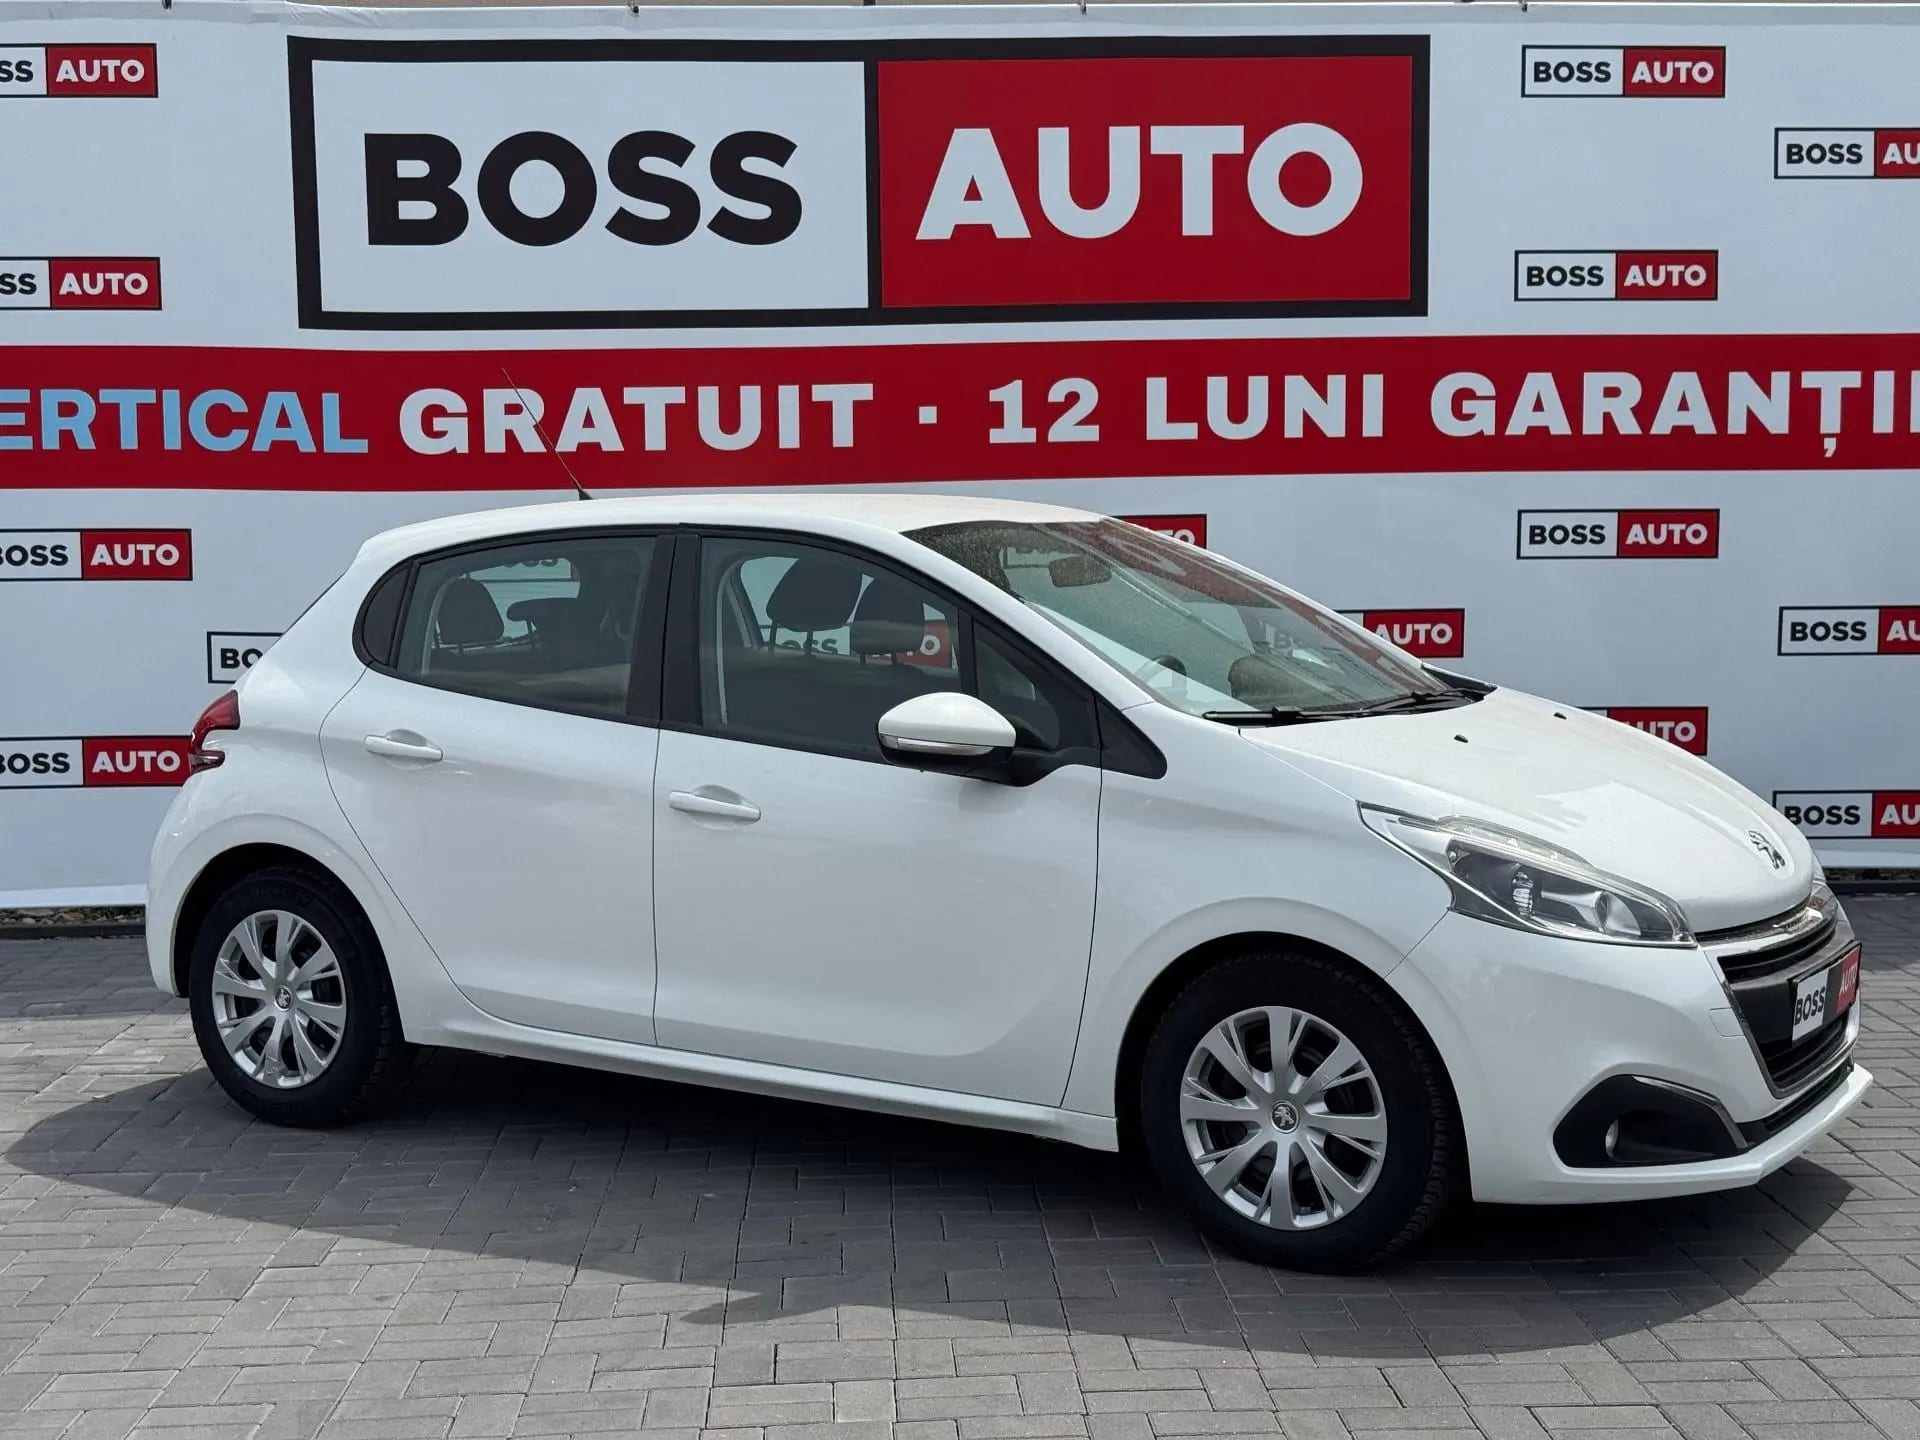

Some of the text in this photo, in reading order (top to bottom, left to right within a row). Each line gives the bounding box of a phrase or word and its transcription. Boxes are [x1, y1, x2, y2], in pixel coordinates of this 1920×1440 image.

[56, 60, 144, 83] AUTO
[1533, 61, 1714, 83] BOSS AUTO
[1786, 144, 1863, 164] BOSS
[364, 123, 1362, 246] BOSS AUTO
[59, 273, 148, 295] AUTO
[1526, 265, 1706, 286] BOSS AUTO
[0, 389, 368, 453] ERTICAL
[400, 383, 873, 454] GRATUIT
[989, 378, 1099, 444] 12
[1146, 374, 1384, 441] LUNI
[1431, 370, 1920, 457] GARANȚI
[1528, 523, 1707, 545] BOSS AUTO
[0, 544, 180, 566] OSS AUTO
[1374, 623, 1453, 645] AUTO
[1790, 621, 1867, 641] BOSS
[0, 751, 181, 774] OSS AUTO
[1784, 805, 1861, 825] BOSS
[1794, 986, 1826, 1025] BOSS
